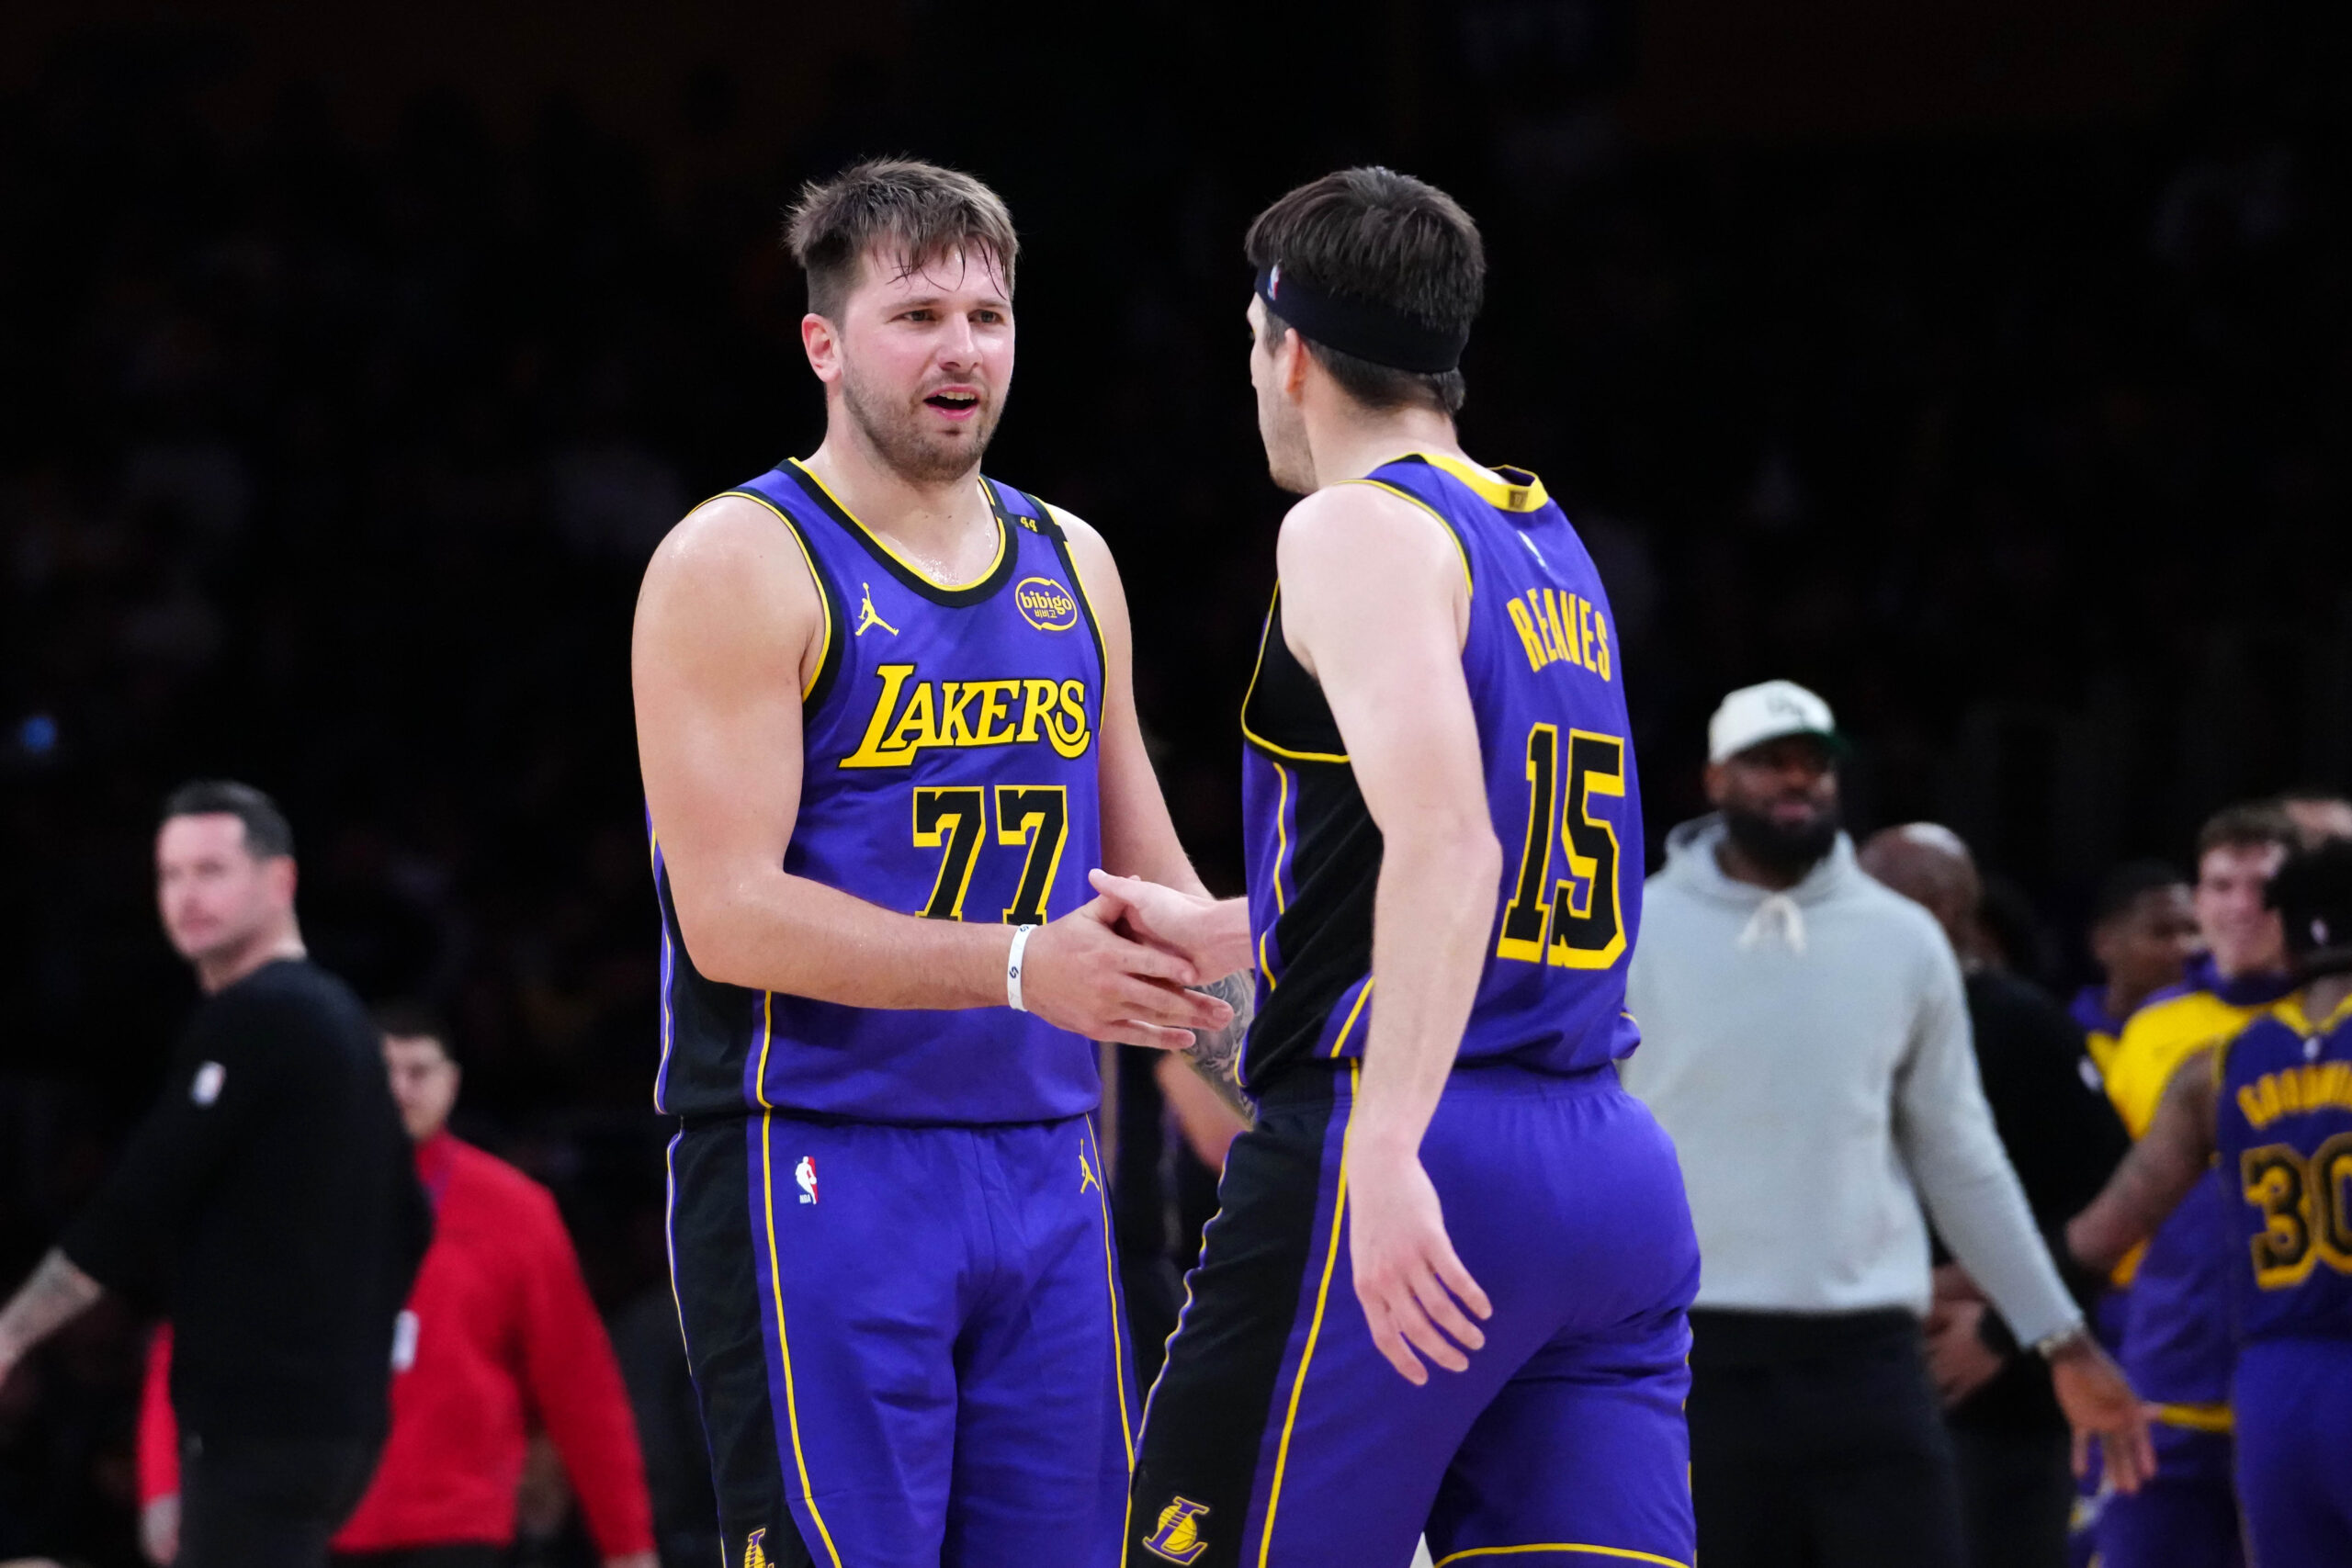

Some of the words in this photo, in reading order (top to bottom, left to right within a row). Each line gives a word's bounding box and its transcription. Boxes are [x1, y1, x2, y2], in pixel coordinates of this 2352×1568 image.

[1020, 516, 1038, 533] 44
[1019, 591, 1072, 615] bibigo
[1506, 587, 1611, 682] REAVES
[838, 662, 1091, 770] LAKERS
[913, 784, 1069, 925] 77
[1497, 721, 1627, 970] 15
